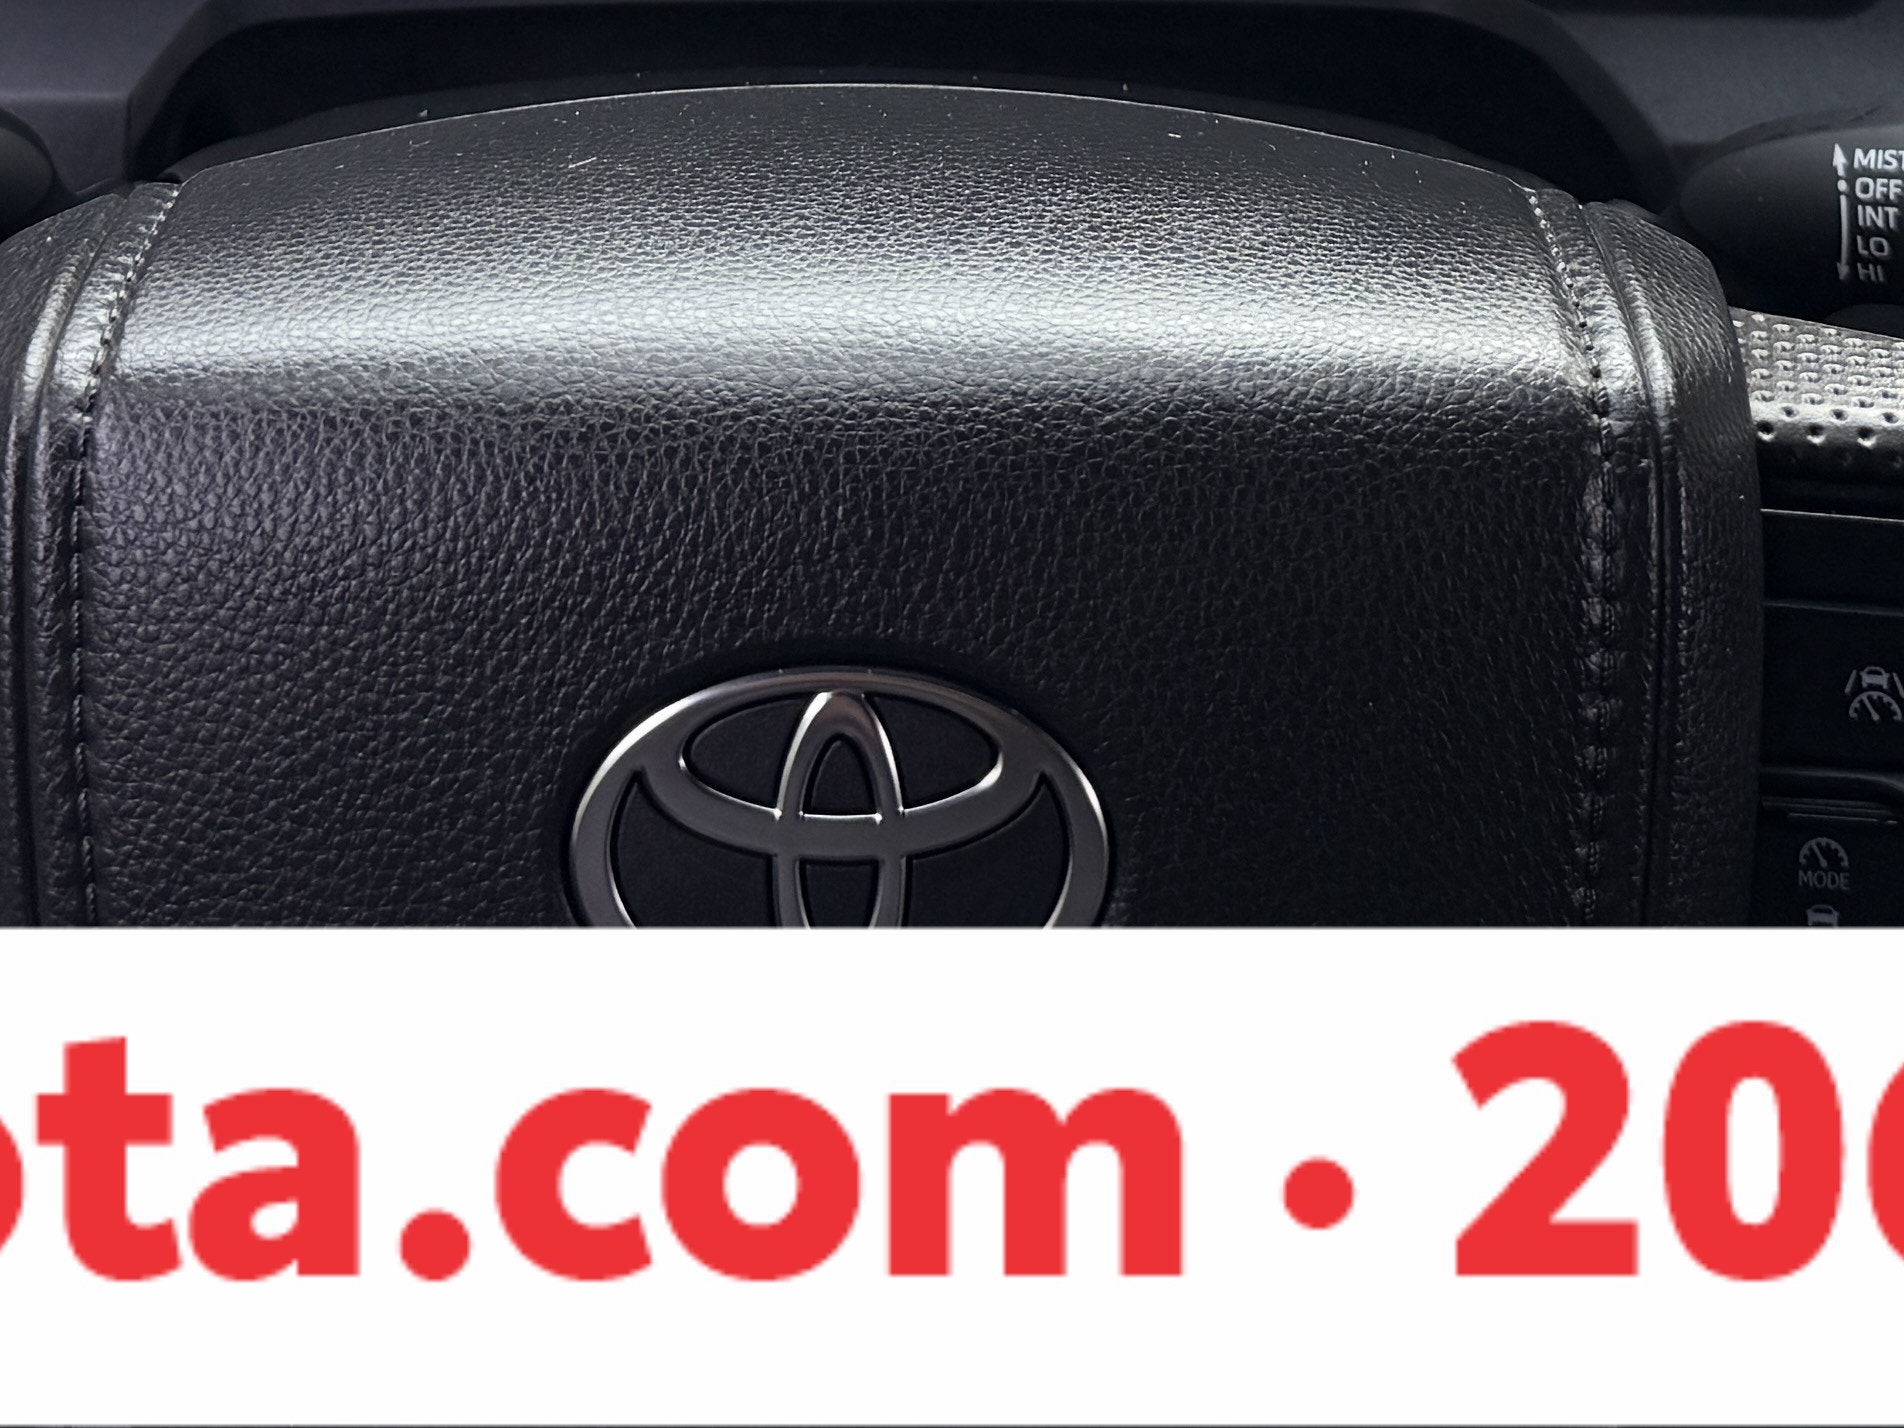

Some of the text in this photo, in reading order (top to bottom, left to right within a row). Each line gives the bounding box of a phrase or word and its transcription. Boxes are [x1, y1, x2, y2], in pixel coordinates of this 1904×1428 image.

[1854, 176, 1903, 201] OFF
[1857, 204, 1899, 229] INT
[1856, 234, 1890, 257] LO
[1856, 262, 1885, 282] HI
[1797, 869, 1851, 891] MODE
